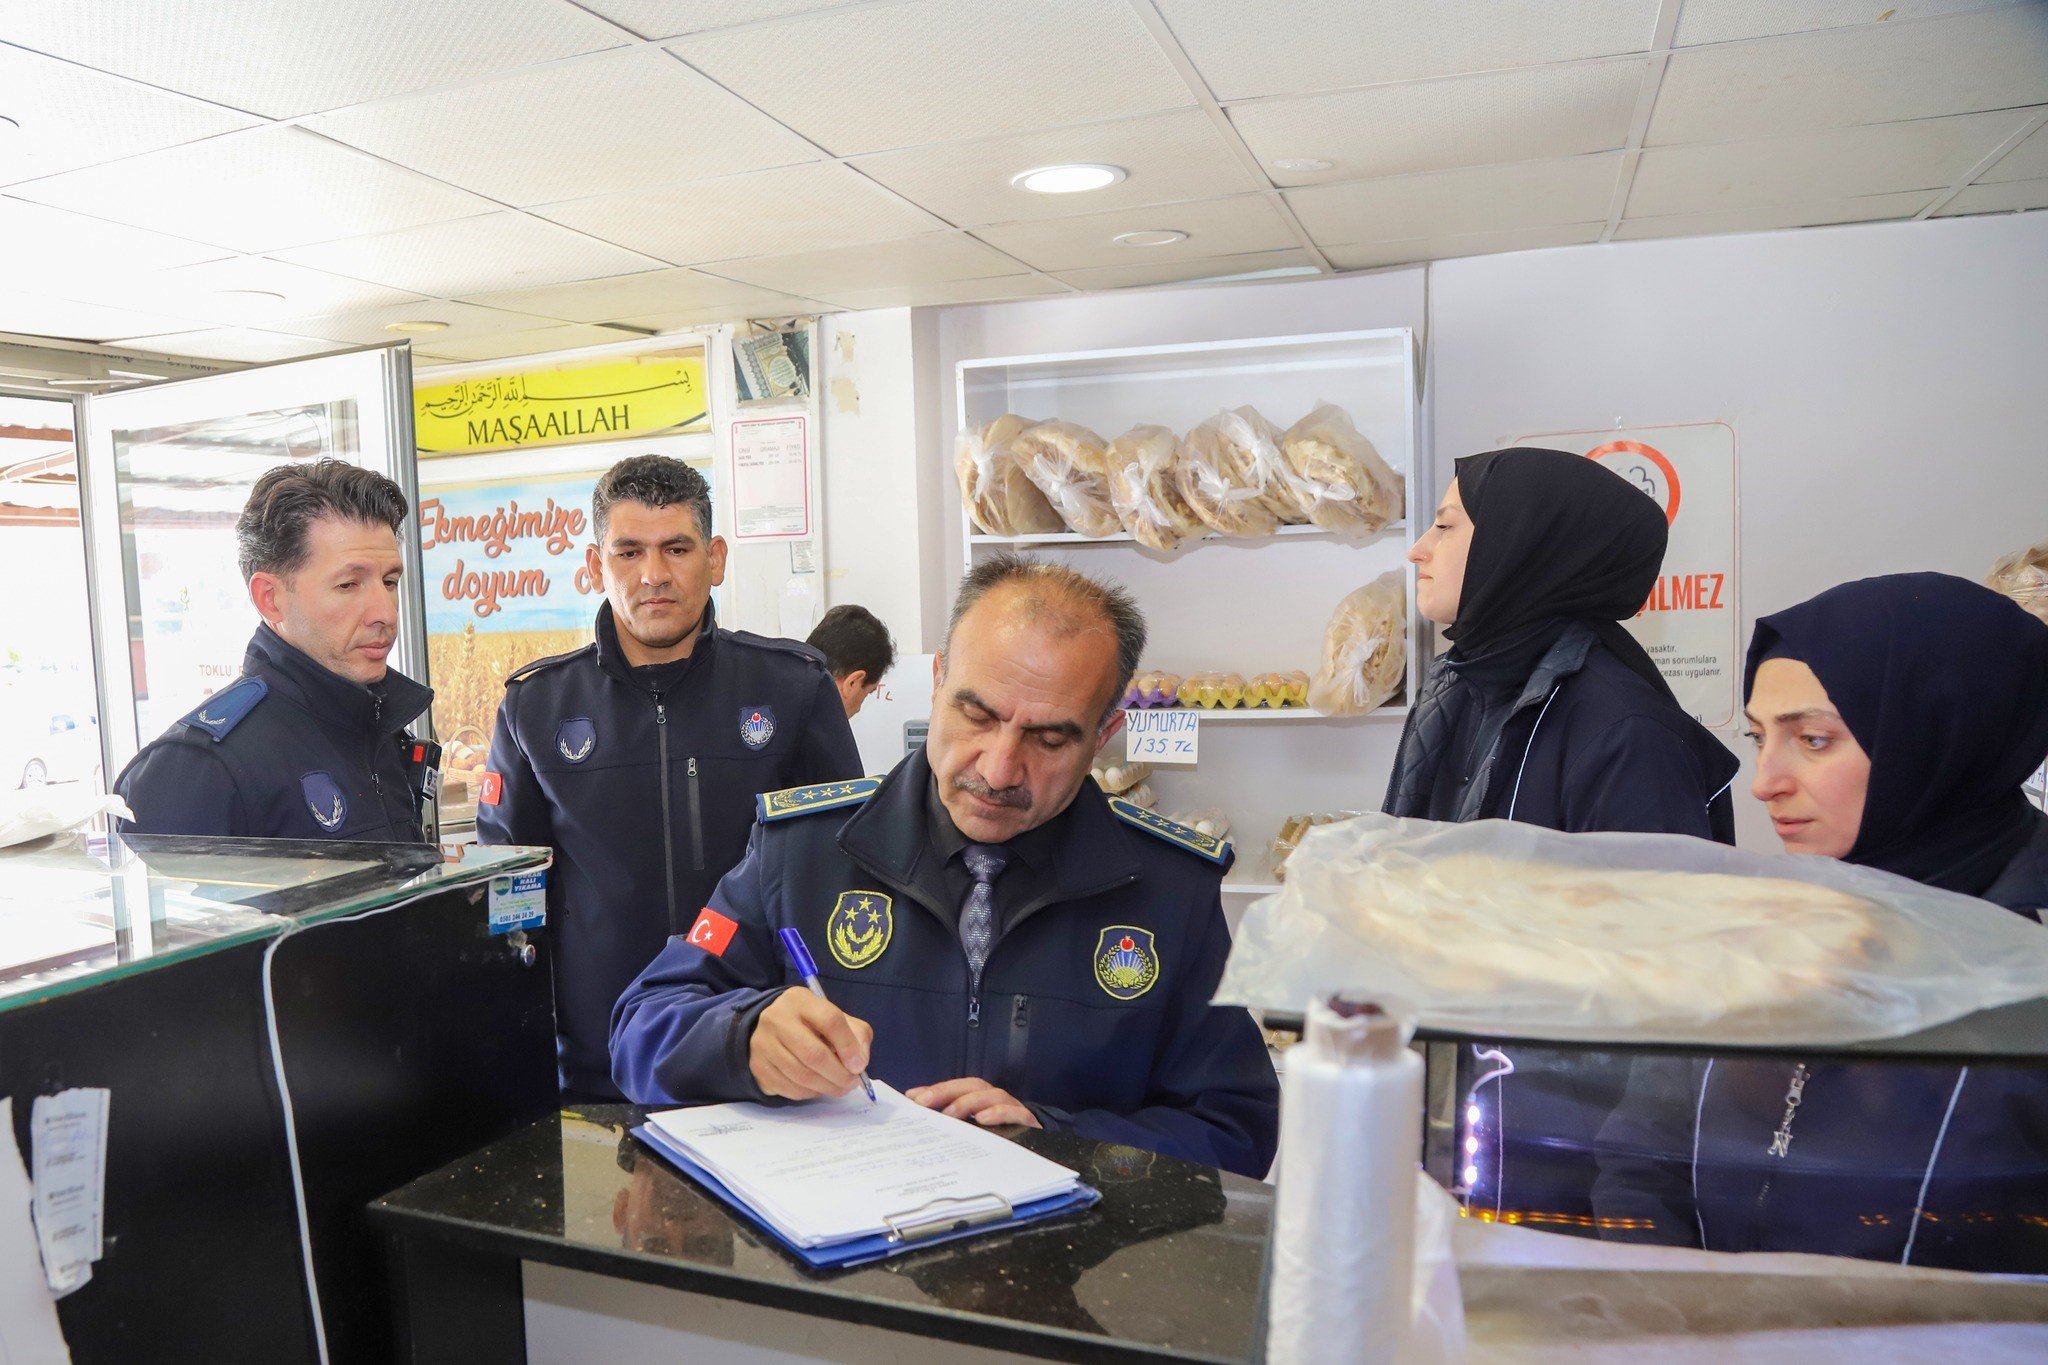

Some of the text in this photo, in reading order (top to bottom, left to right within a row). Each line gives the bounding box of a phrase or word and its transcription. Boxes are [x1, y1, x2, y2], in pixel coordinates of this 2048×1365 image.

[467, 403, 631, 446] MAŞAALLAH
[420, 497, 588, 559] Ekmeğimize
[442, 559, 551, 618] doyum
[1672, 655, 1717, 665] sorumlulara
[199, 664, 232, 677] TOKLU
[1685, 666, 1722, 678] uygulanır.
[1128, 711, 1197, 732] YUMURTA
[514, 883, 541, 892] YIKAMA
